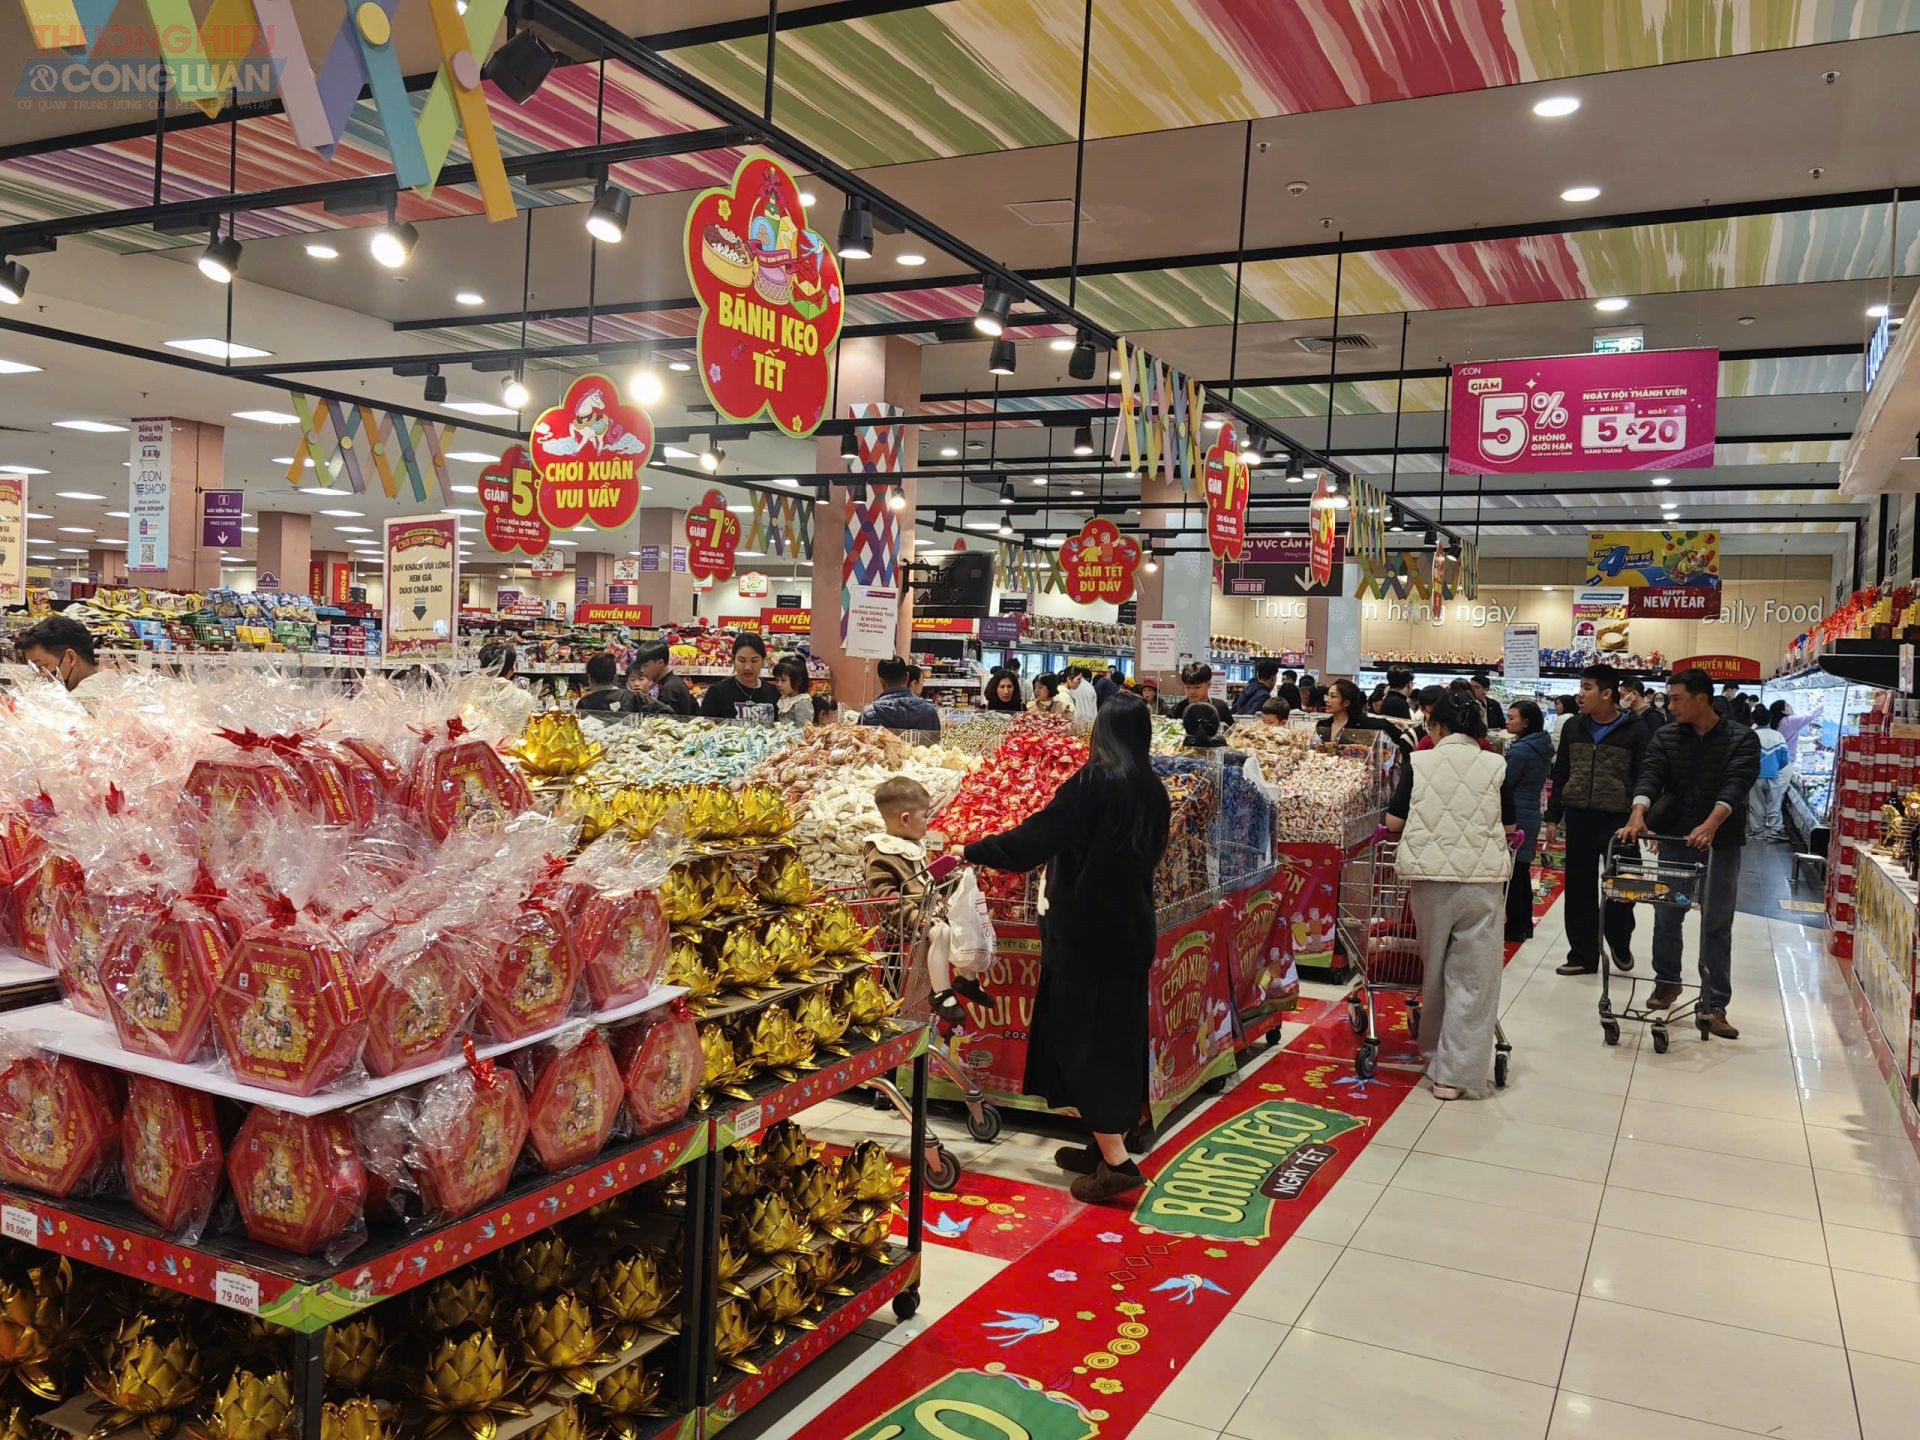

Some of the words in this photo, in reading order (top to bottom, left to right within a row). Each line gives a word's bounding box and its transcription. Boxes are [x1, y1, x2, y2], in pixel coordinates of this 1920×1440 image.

[719, 291, 776, 344] BÁNH
[781, 314, 819, 357] KẸO
[752, 348, 787, 392] TẾT
[1470, 379, 1501, 392] GIẢM
[1583, 391, 1610, 400] NGÀY
[1611, 390, 1628, 400] HỘI
[1630, 388, 1663, 398] THÀNH
[1664, 387, 1688, 396] VIÊN
[1532, 432, 1567, 442] KHÔNG
[1598, 416, 1618, 442] 5
[1625, 422, 1638, 436] &
[1638, 419, 1680, 444] 20
[138, 433, 163, 443] Online
[1552, 442, 1573, 451] HẠN
[546, 459, 583, 482] CHƠI
[587, 456, 634, 481] XUÂN
[556, 489, 584, 509] VUI
[587, 481, 621, 508] VẦY
[1256, 539, 1278, 550] VỰC
[1280, 538, 1303, 548] CÂN
[1598, 545, 1630, 577] 4
[1104, 562, 1124, 577] TẾT
[409, 574, 421, 583] XEM
[1643, 596, 1672, 608] NEW
[1673, 596, 1705, 608] YEAR
[589, 607, 623, 619] KHUYẾN
[624, 609, 641, 622] MẠI
[771, 611, 811, 624] KHUYẾN
[1250, 595, 1308, 623] Thực
[1456, 597, 1518, 627] ngày
[1604, 608, 1626, 619] 2H
[1763, 596, 1824, 624] Food
[1164, 998, 1185, 1037] VUI
[1296, 1147, 1329, 1175] TẾT
